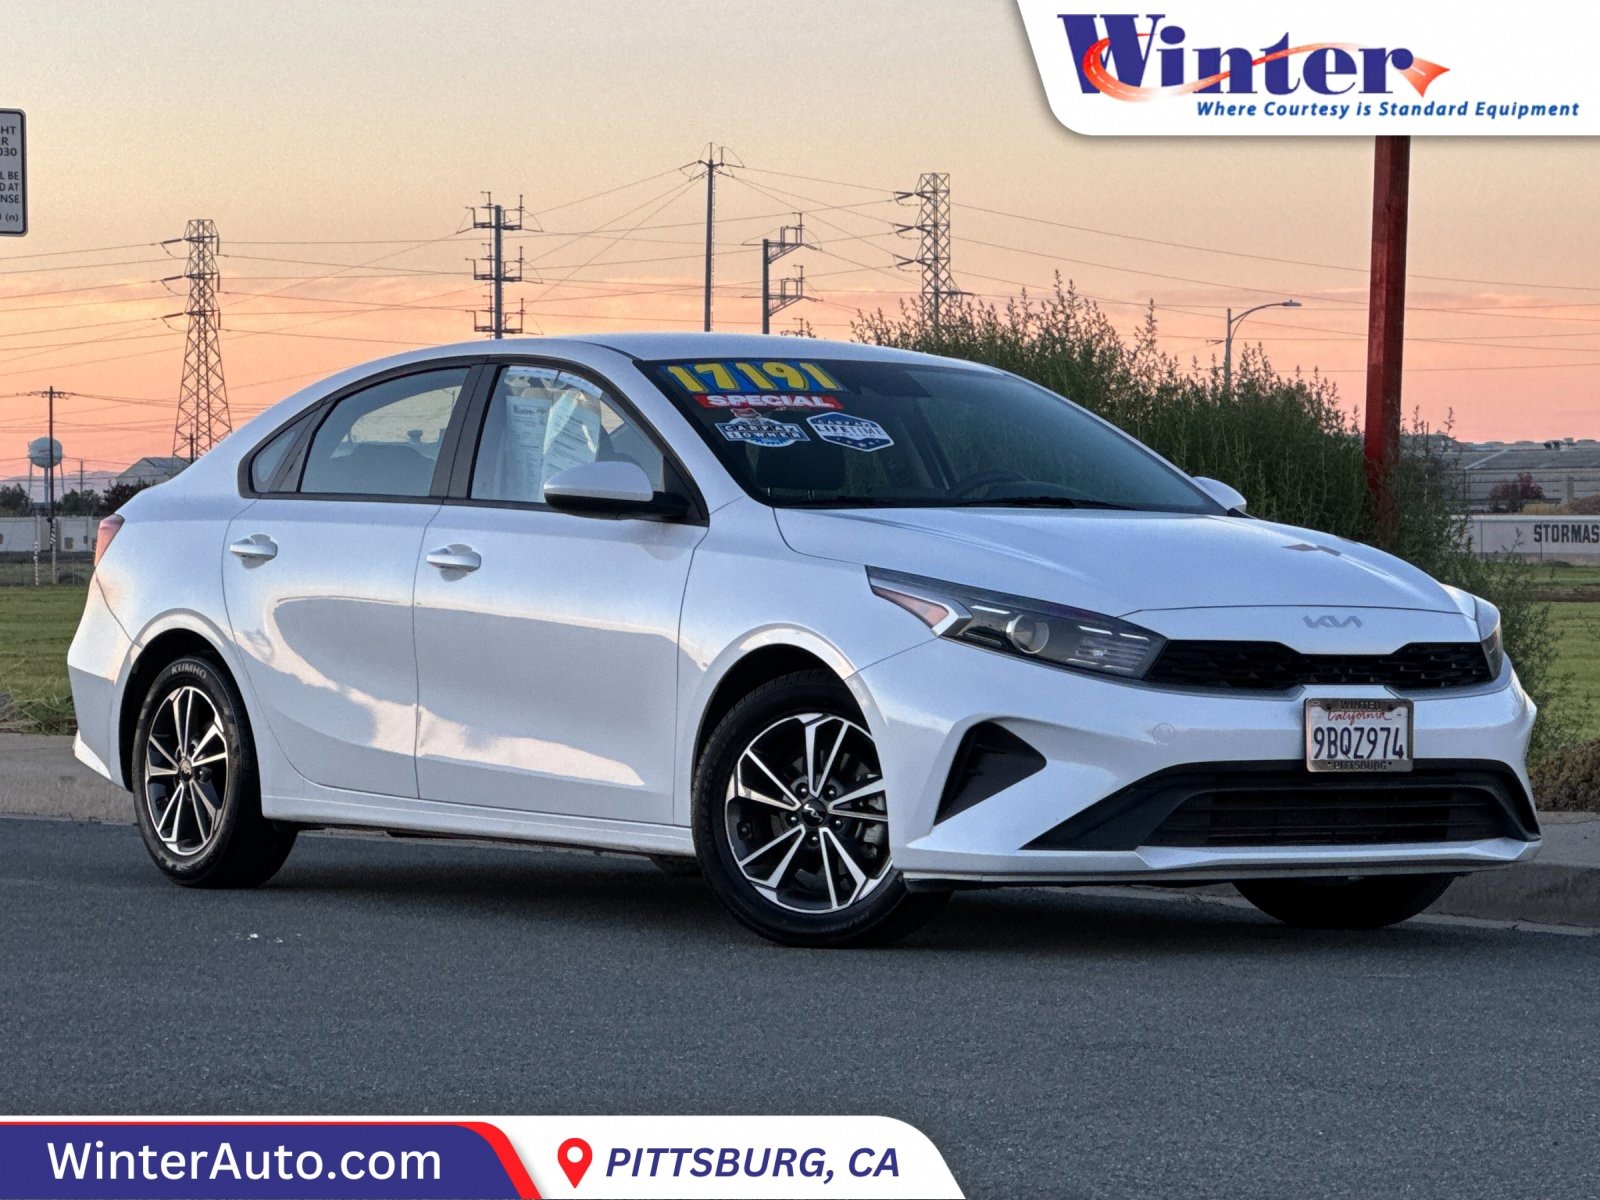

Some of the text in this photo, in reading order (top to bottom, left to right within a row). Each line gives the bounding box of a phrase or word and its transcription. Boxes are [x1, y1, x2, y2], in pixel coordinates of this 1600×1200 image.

[0, 126, 16, 135] HT
[8, 171, 19, 180] BE
[8, 182, 20, 192] AT
[667, 362, 837, 392] 17191
[706, 395, 835, 408] SPECIAL
[724, 425, 799, 433] CARFAX
[815, 425, 885, 436] LIFETIME
[1533, 524, 1600, 544] STORMAS
[171, 663, 207, 679] KUMHO
[1341, 701, 1381, 710] WINTER
[1328, 710, 1392, 726] California
[1313, 726, 1404, 760] 9BQZ974
